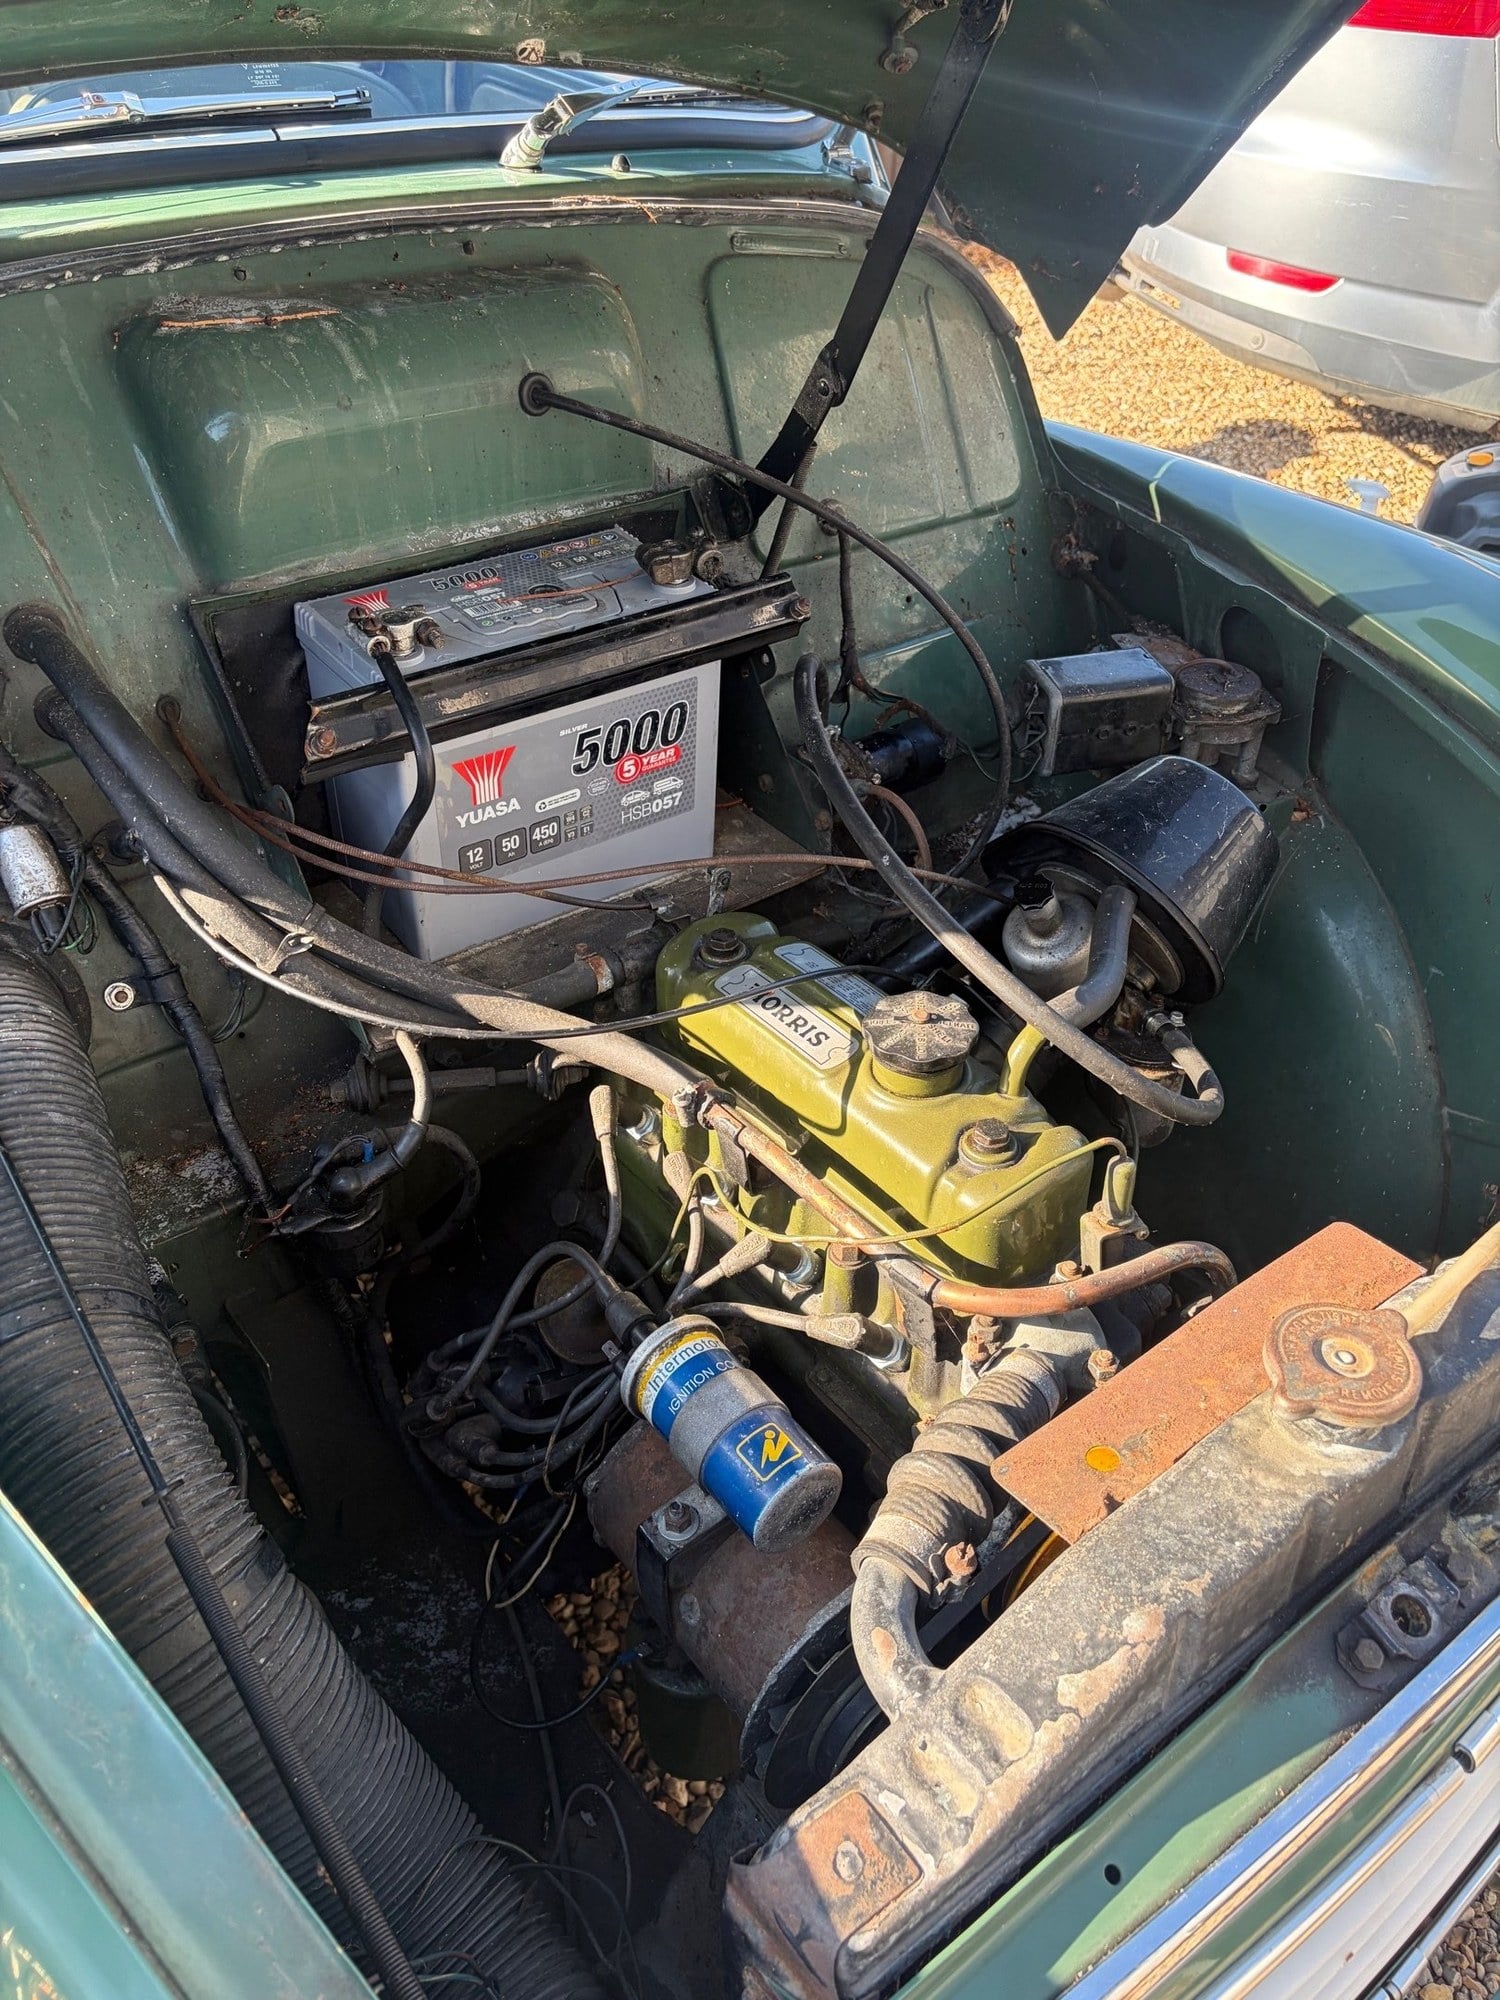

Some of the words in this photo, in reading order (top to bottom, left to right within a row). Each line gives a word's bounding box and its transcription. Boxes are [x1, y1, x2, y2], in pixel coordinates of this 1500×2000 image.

[431, 566, 498, 591] 5000
[560, 723, 588, 736] SILVER
[571, 700, 689, 776] 5000
[622, 760, 637, 778] 5
[642, 748, 675, 764] YEAR
[456, 798, 521, 828] YUASA
[621, 791, 682, 824] HSB057
[532, 822, 558, 841] 450
[502, 834, 520, 852] 50
[466, 846, 484, 864] 12
[469, 861, 484, 871] VOLT
[668, 1366, 715, 1415] IGNITION
[715, 1360, 735, 1372] CO
[1340, 1382, 1397, 1400] REMOVE
